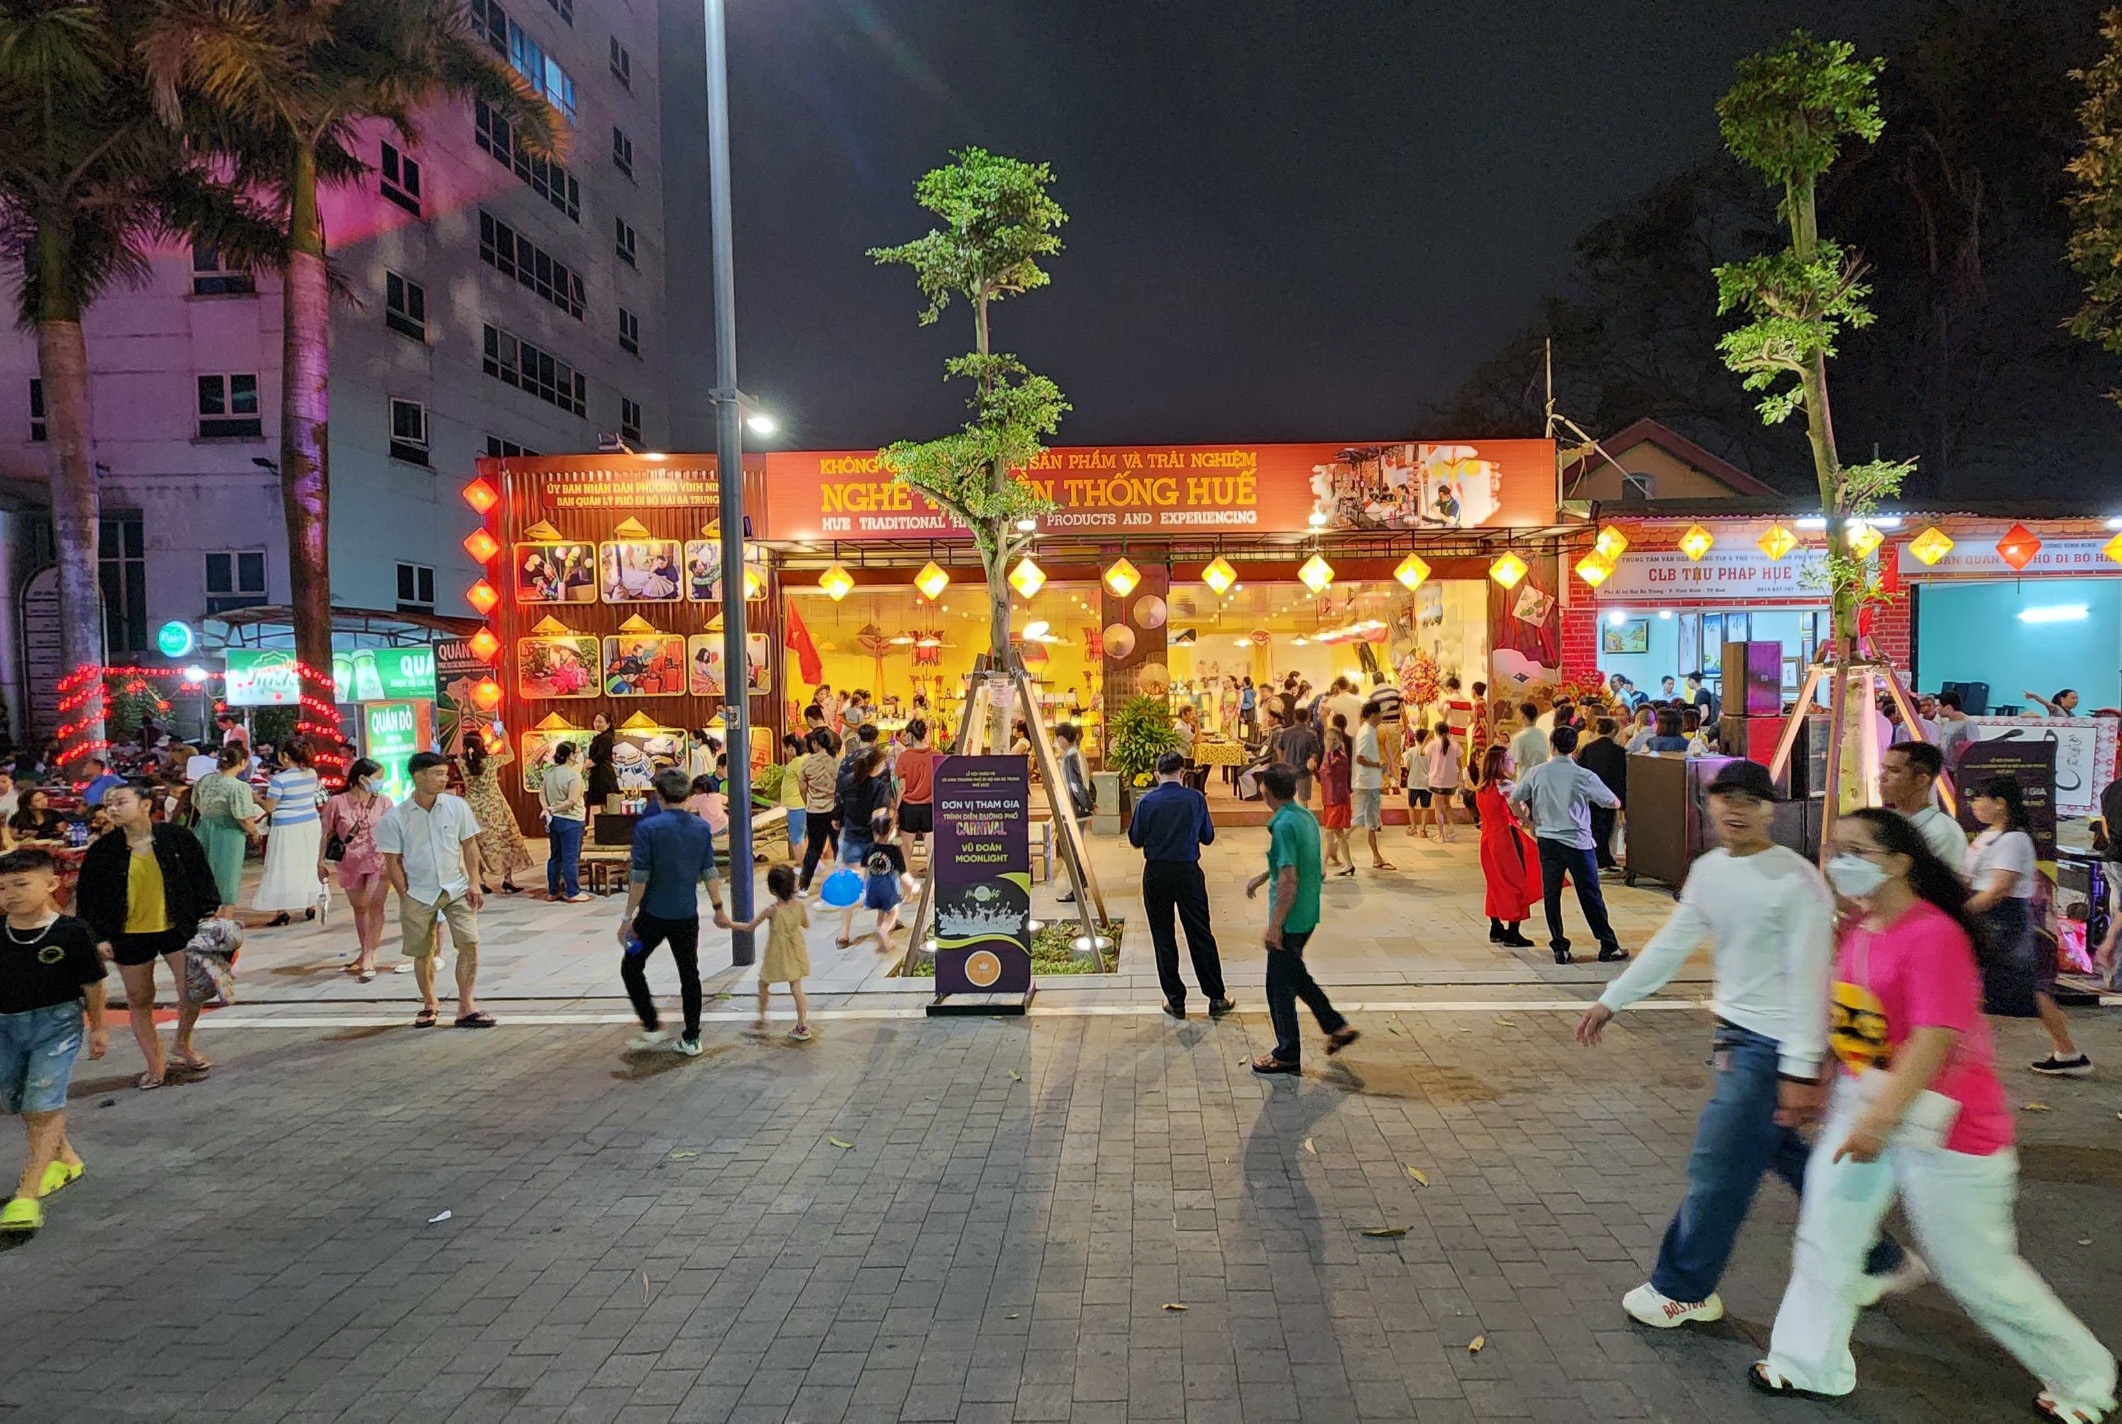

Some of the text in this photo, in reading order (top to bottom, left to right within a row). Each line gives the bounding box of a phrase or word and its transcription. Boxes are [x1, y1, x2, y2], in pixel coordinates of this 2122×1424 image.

[820, 455, 879, 474] KHÔNG
[1068, 448, 1117, 469] PHẨM
[1122, 450, 1144, 469] VÀ
[1147, 449, 1185, 468] TRẢI
[1190, 449, 1258, 469] NGHIỆM
[562, 483, 582, 494] BAN
[1063, 470, 1180, 507] THỐNG
[1186, 467, 1258, 506] HUẾ
[556, 496, 575, 507] BAN
[822, 516, 852, 531] HUE
[859, 515, 946, 530] TRADITIONAL
[1046, 513, 1117, 527] PRODUCTS
[1122, 512, 1153, 525] AND
[1159, 510, 1258, 525] EXPERIENCING
[2056, 553, 2069, 564] ĐI
[1649, 568, 1677, 582] CLB
[371, 704, 413, 735] QUÁN ĐỎ
[941, 799, 1020, 811] ĐƠN VỊ THAM GIA
[1004, 811, 1019, 819] PHỐ
[955, 821, 1008, 836] CARNIVAL
[955, 854, 1009, 863] MOONLIGHT
